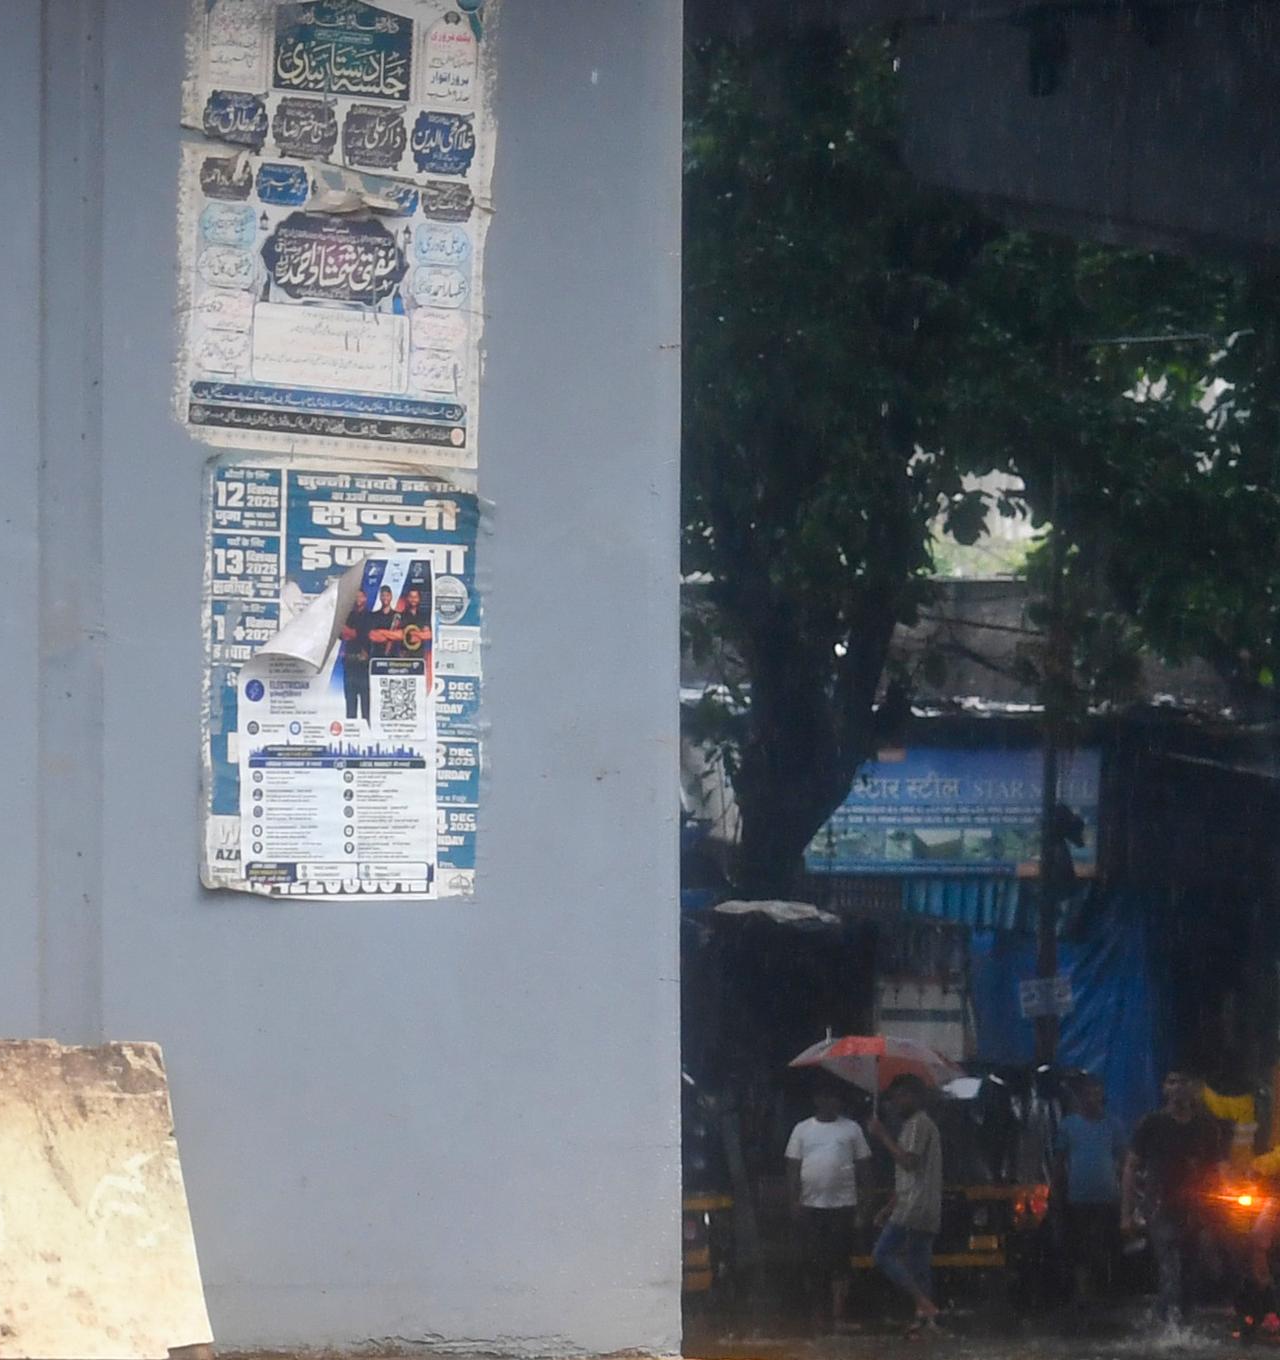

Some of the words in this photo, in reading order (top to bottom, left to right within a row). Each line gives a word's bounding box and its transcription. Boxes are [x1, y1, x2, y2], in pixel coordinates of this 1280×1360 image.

[216, 481, 244, 507] 12
[246, 496, 279, 508] 2025
[308, 498, 461, 537] सुन्नी
[214, 548, 244, 574] 13
[245, 563, 278, 575] 2025
[448, 682, 474, 692] DEC
[448, 748, 473, 758] DEC
[448, 757, 476, 767] 2025
[449, 813, 475, 822] DEC
[449, 822, 477, 832] 2025
[216, 848, 241, 861] AZA
